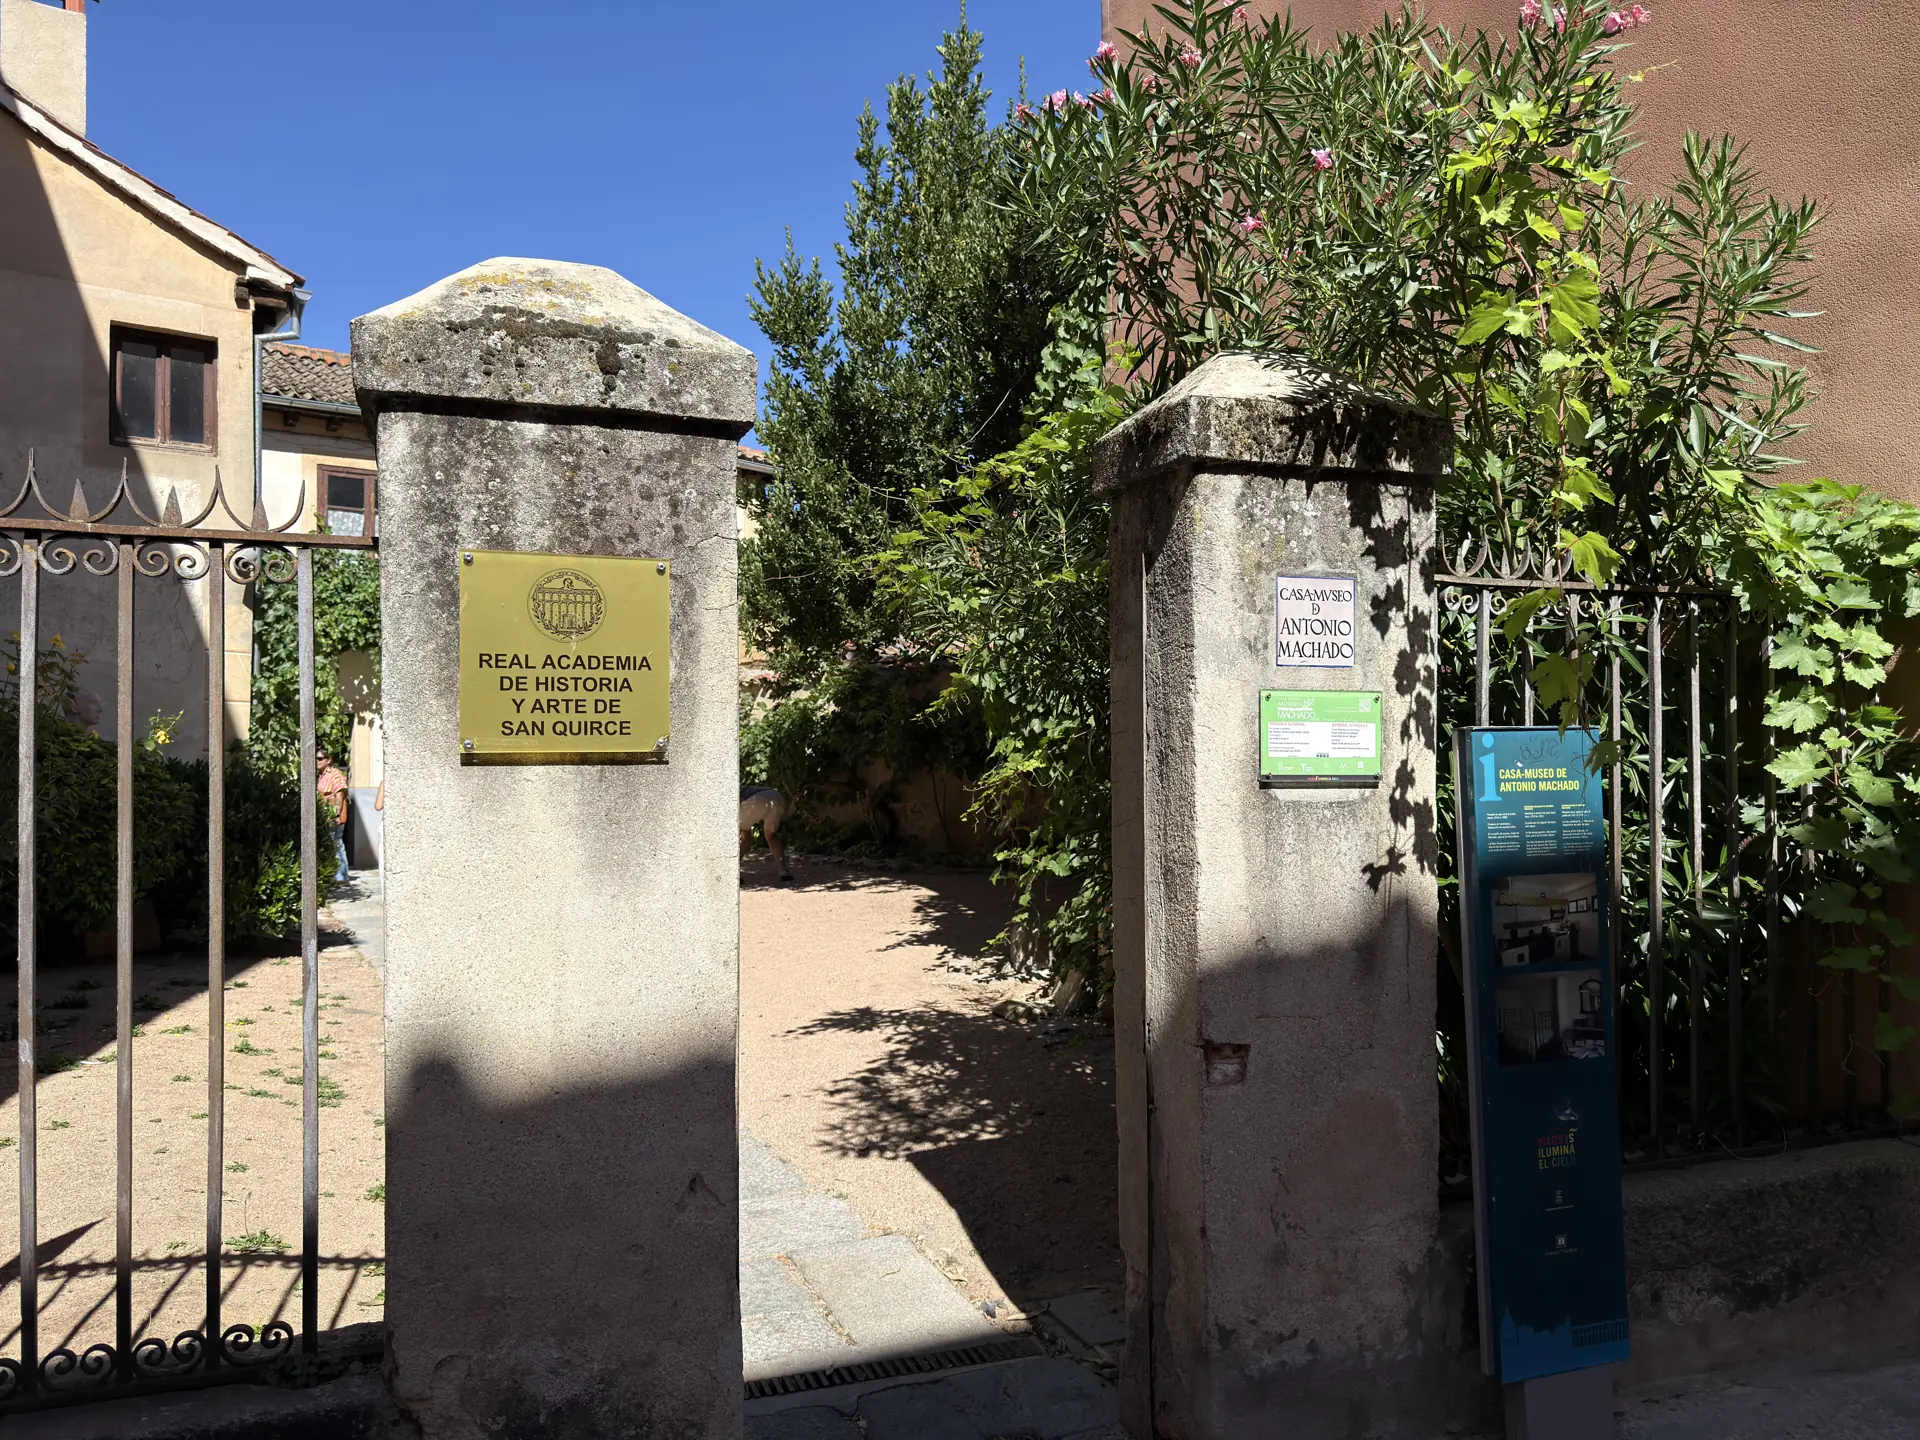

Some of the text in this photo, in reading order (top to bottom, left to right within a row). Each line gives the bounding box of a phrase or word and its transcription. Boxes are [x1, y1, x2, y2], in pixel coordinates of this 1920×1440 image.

[1280, 618, 1352, 636] ANTONIO
[1278, 641, 1354, 659] MACHADO
[479, 653, 652, 671] REAL ACADEMIA
[499, 676, 633, 693] DE HISTORIA
[511, 698, 621, 714] Y ARTE DE
[1277, 710, 1316, 719] MACHADO
[501, 720, 631, 737] SAN QUIRCE
[1499, 768, 1567, 779] CASA-MUSEO DE
[1500, 780, 1580, 792] ANTONIO MACHADO
[1538, 1144, 1576, 1158] ILUMINA
[1539, 1159, 1550, 1170] EL
